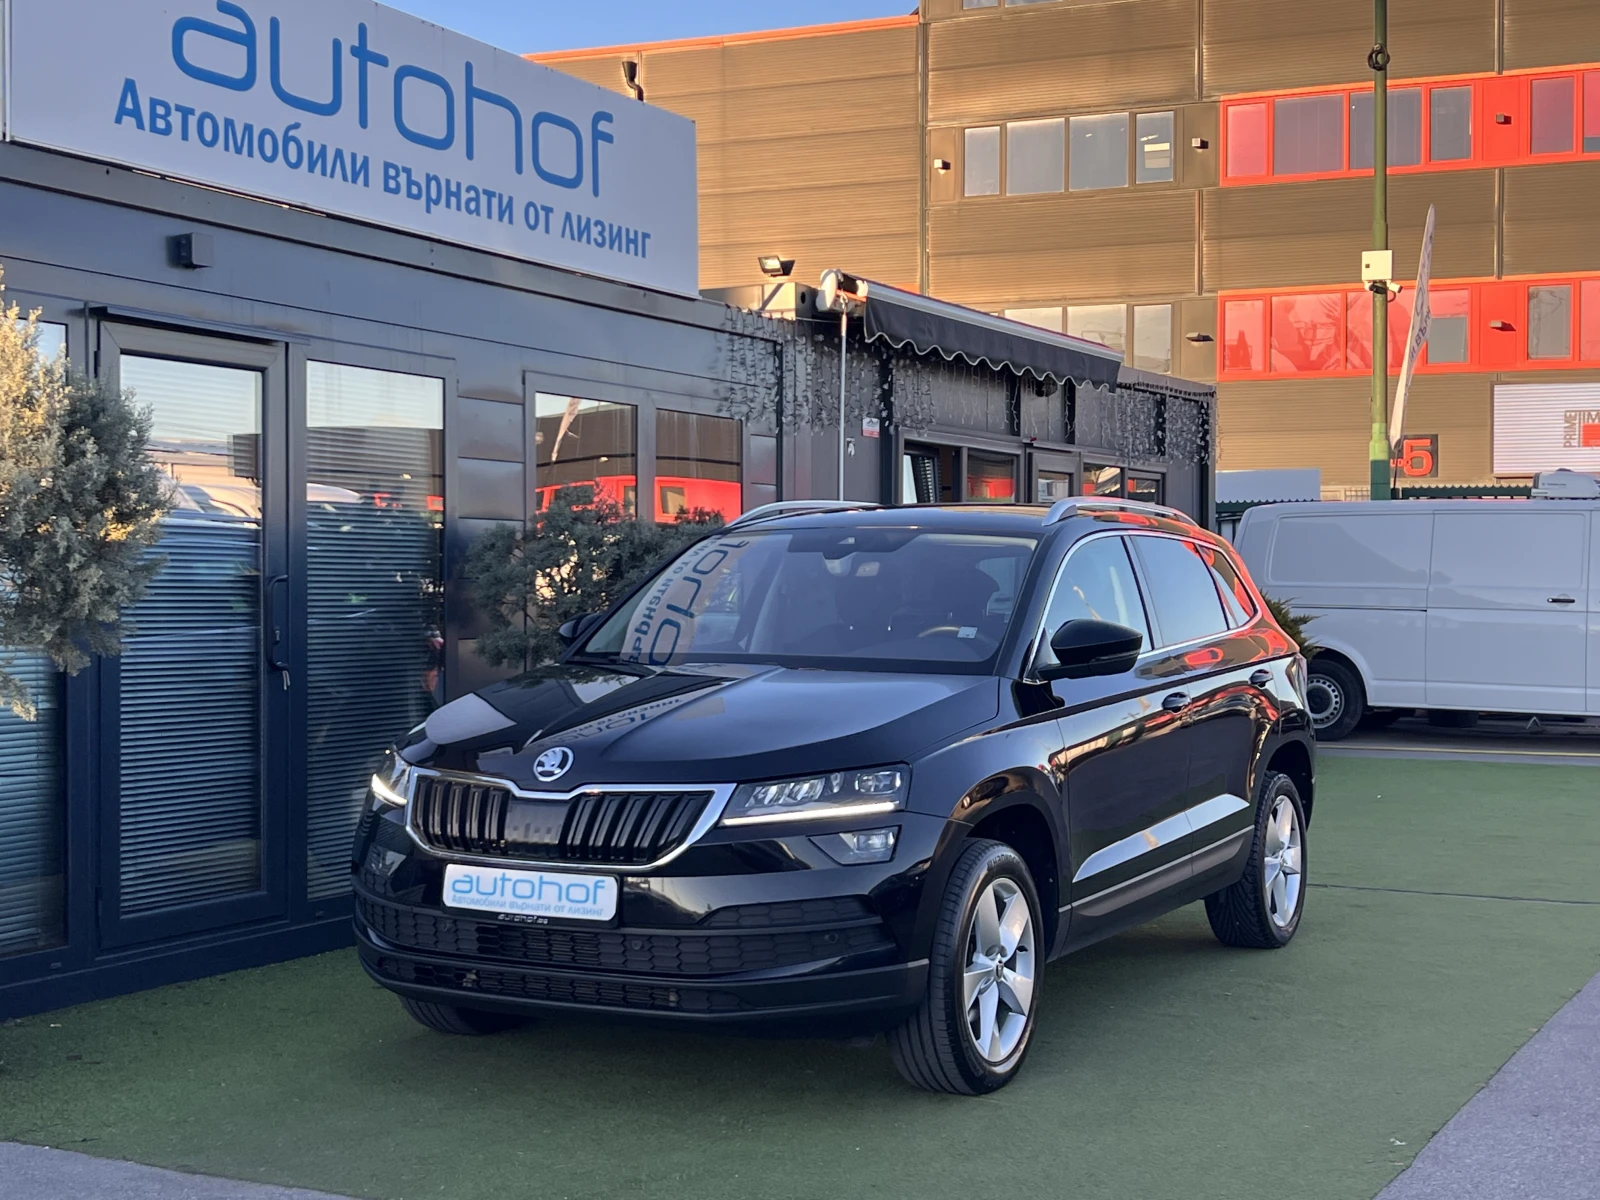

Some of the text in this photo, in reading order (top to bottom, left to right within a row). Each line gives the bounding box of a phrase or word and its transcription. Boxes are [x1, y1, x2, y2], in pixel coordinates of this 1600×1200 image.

[170, 0, 616, 198] autohof
[113, 77, 652, 259] Автомобили върнати от лизинг
[1564, 410, 1577, 448] PRIME
[1403, 438, 1432, 476] 5
[451, 872, 605, 905] autohof
[452, 894, 604, 917] Автомобили върнати от лизинг
